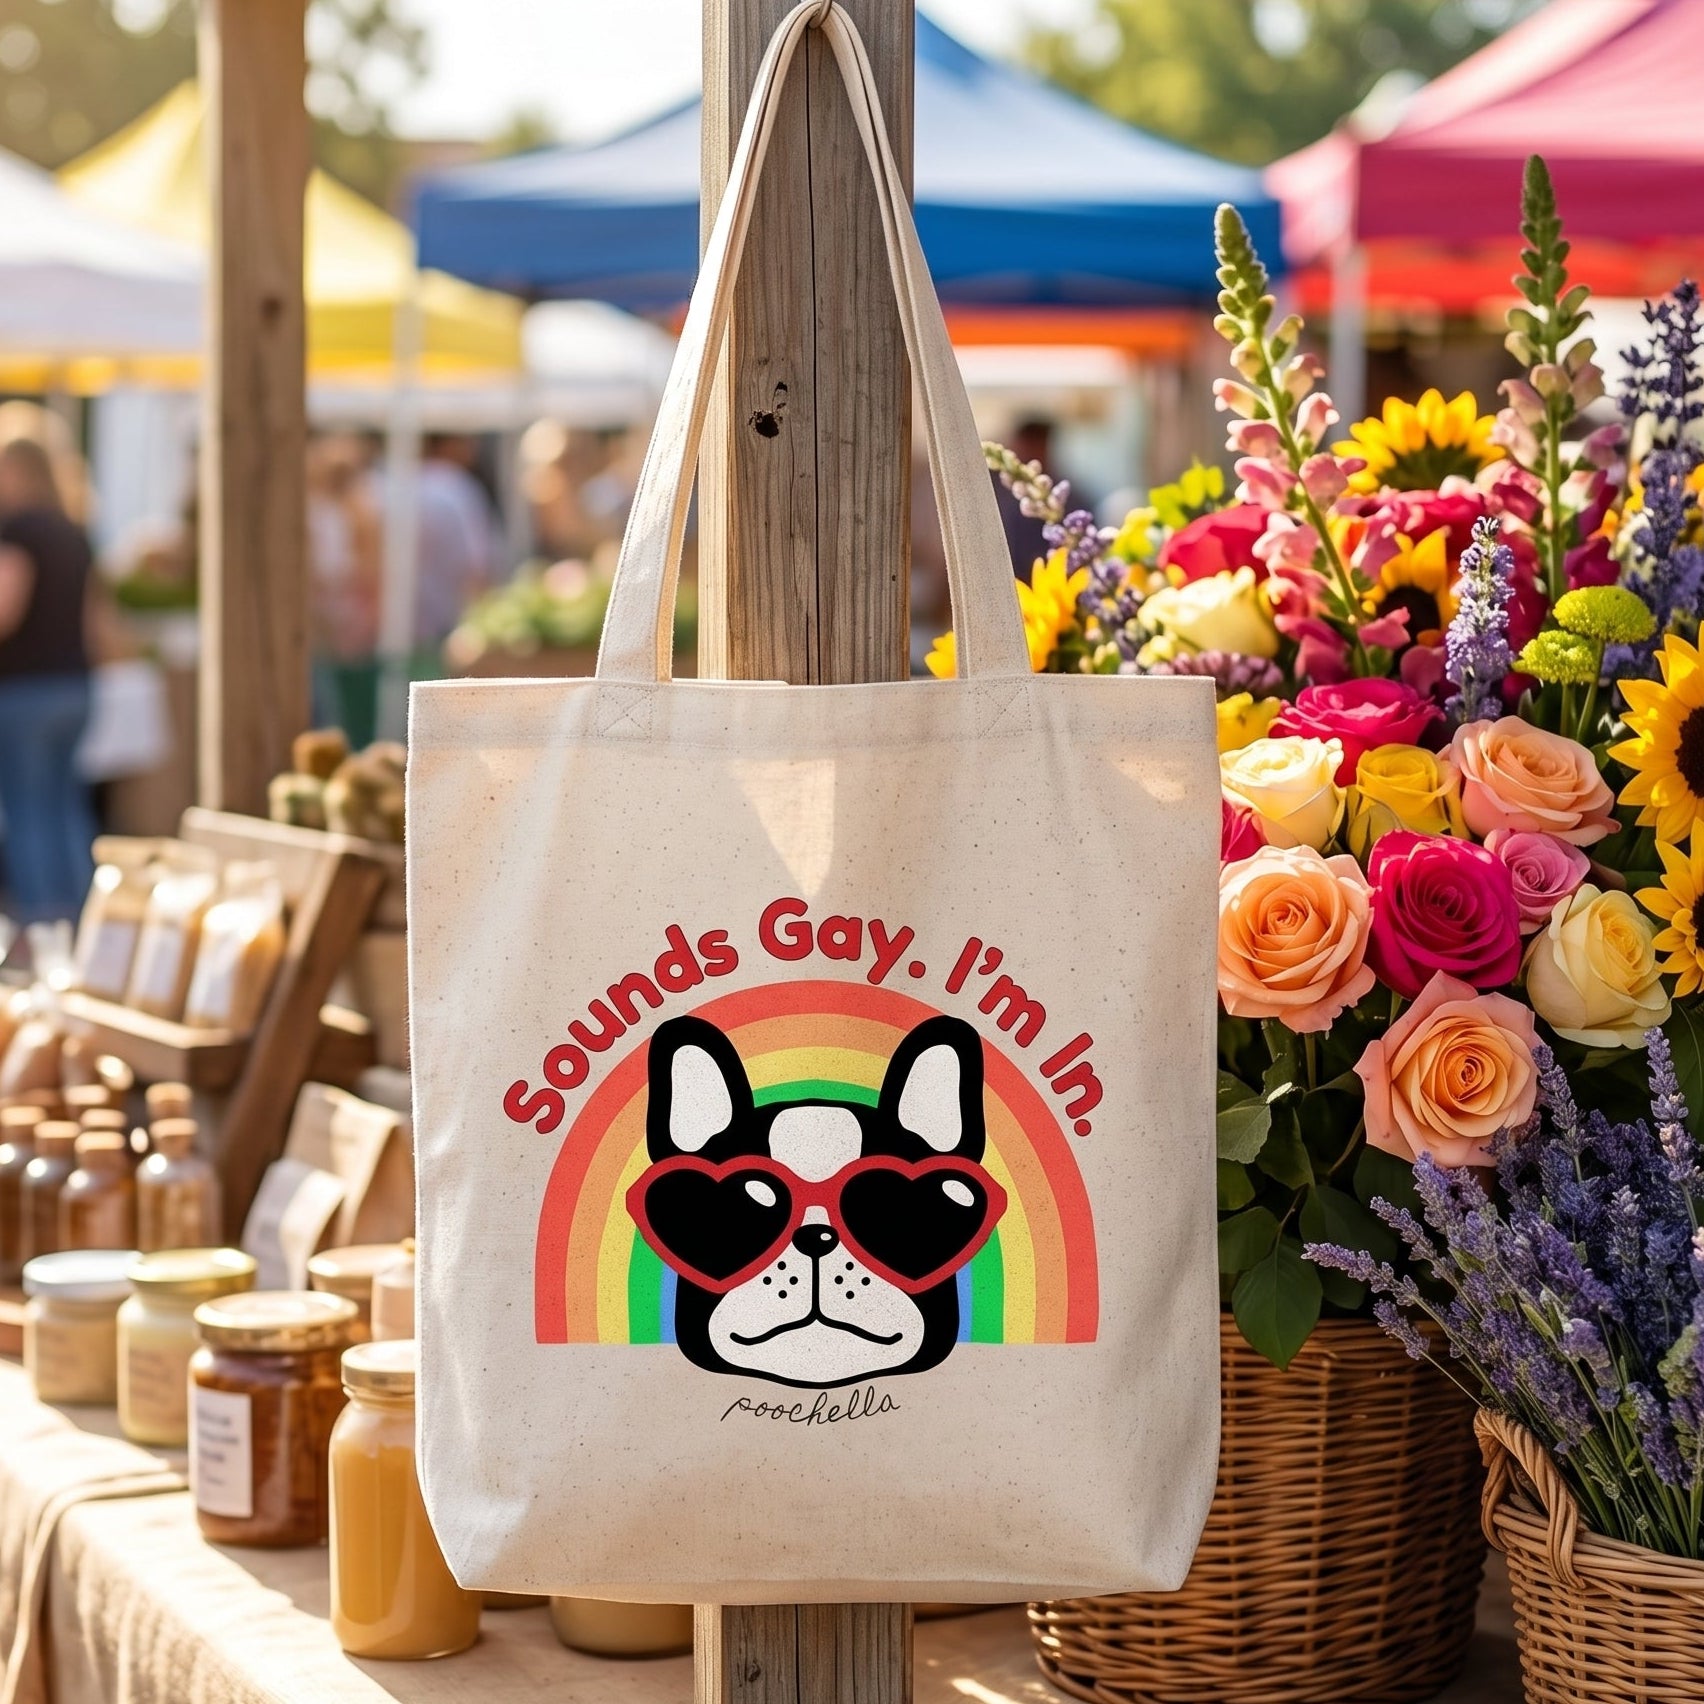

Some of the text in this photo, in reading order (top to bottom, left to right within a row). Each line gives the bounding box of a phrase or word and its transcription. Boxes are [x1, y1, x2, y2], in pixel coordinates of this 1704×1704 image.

[503, 897, 1104, 1138] Sounds Gay. I'm In.
[720, 1385, 901, 1426] poochella
